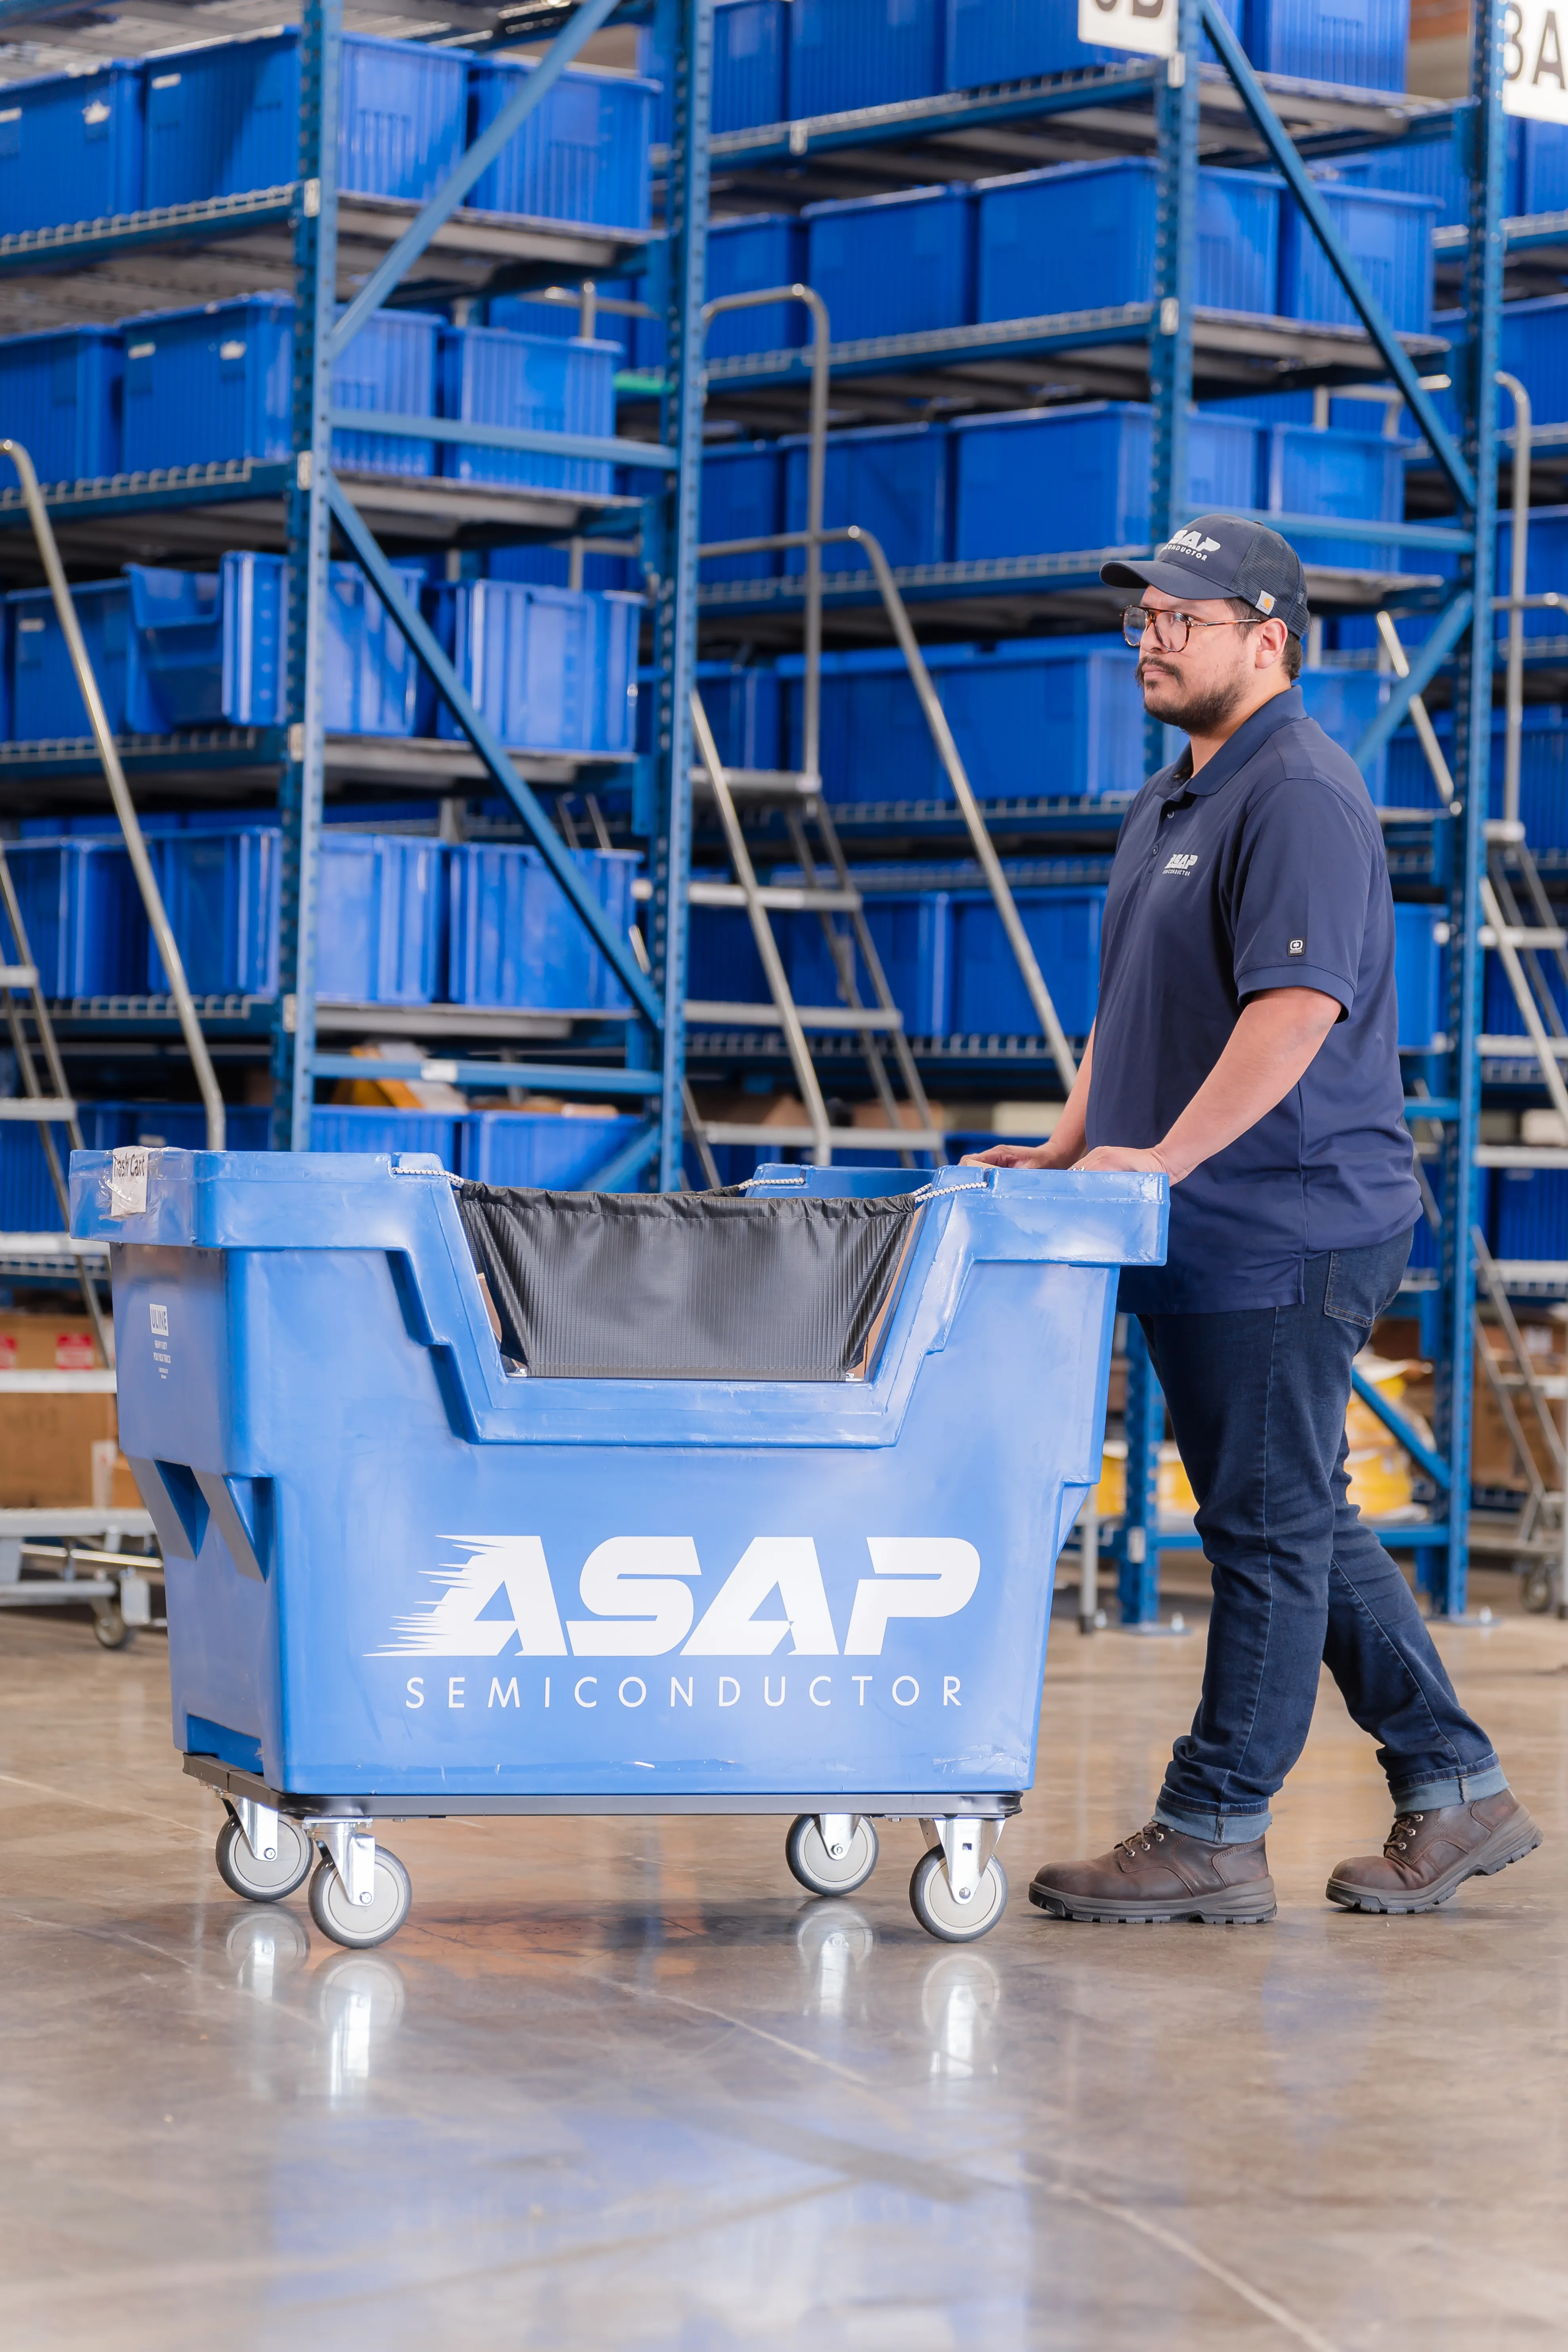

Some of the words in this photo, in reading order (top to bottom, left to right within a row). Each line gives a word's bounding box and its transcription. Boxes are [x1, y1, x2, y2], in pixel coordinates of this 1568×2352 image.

[1169, 529, 1221, 551] SAP
[1164, 544, 1208, 561] CONDUCTOR
[1164, 854, 1198, 869] ASAP
[113, 1153, 129, 1177] Trash
[130, 1154, 145, 1176] Cart
[151, 1309, 167, 1331] ULINE
[362, 1535, 981, 1656] ASAP
[406, 1675, 962, 1708] SEMICONDUCTOR
